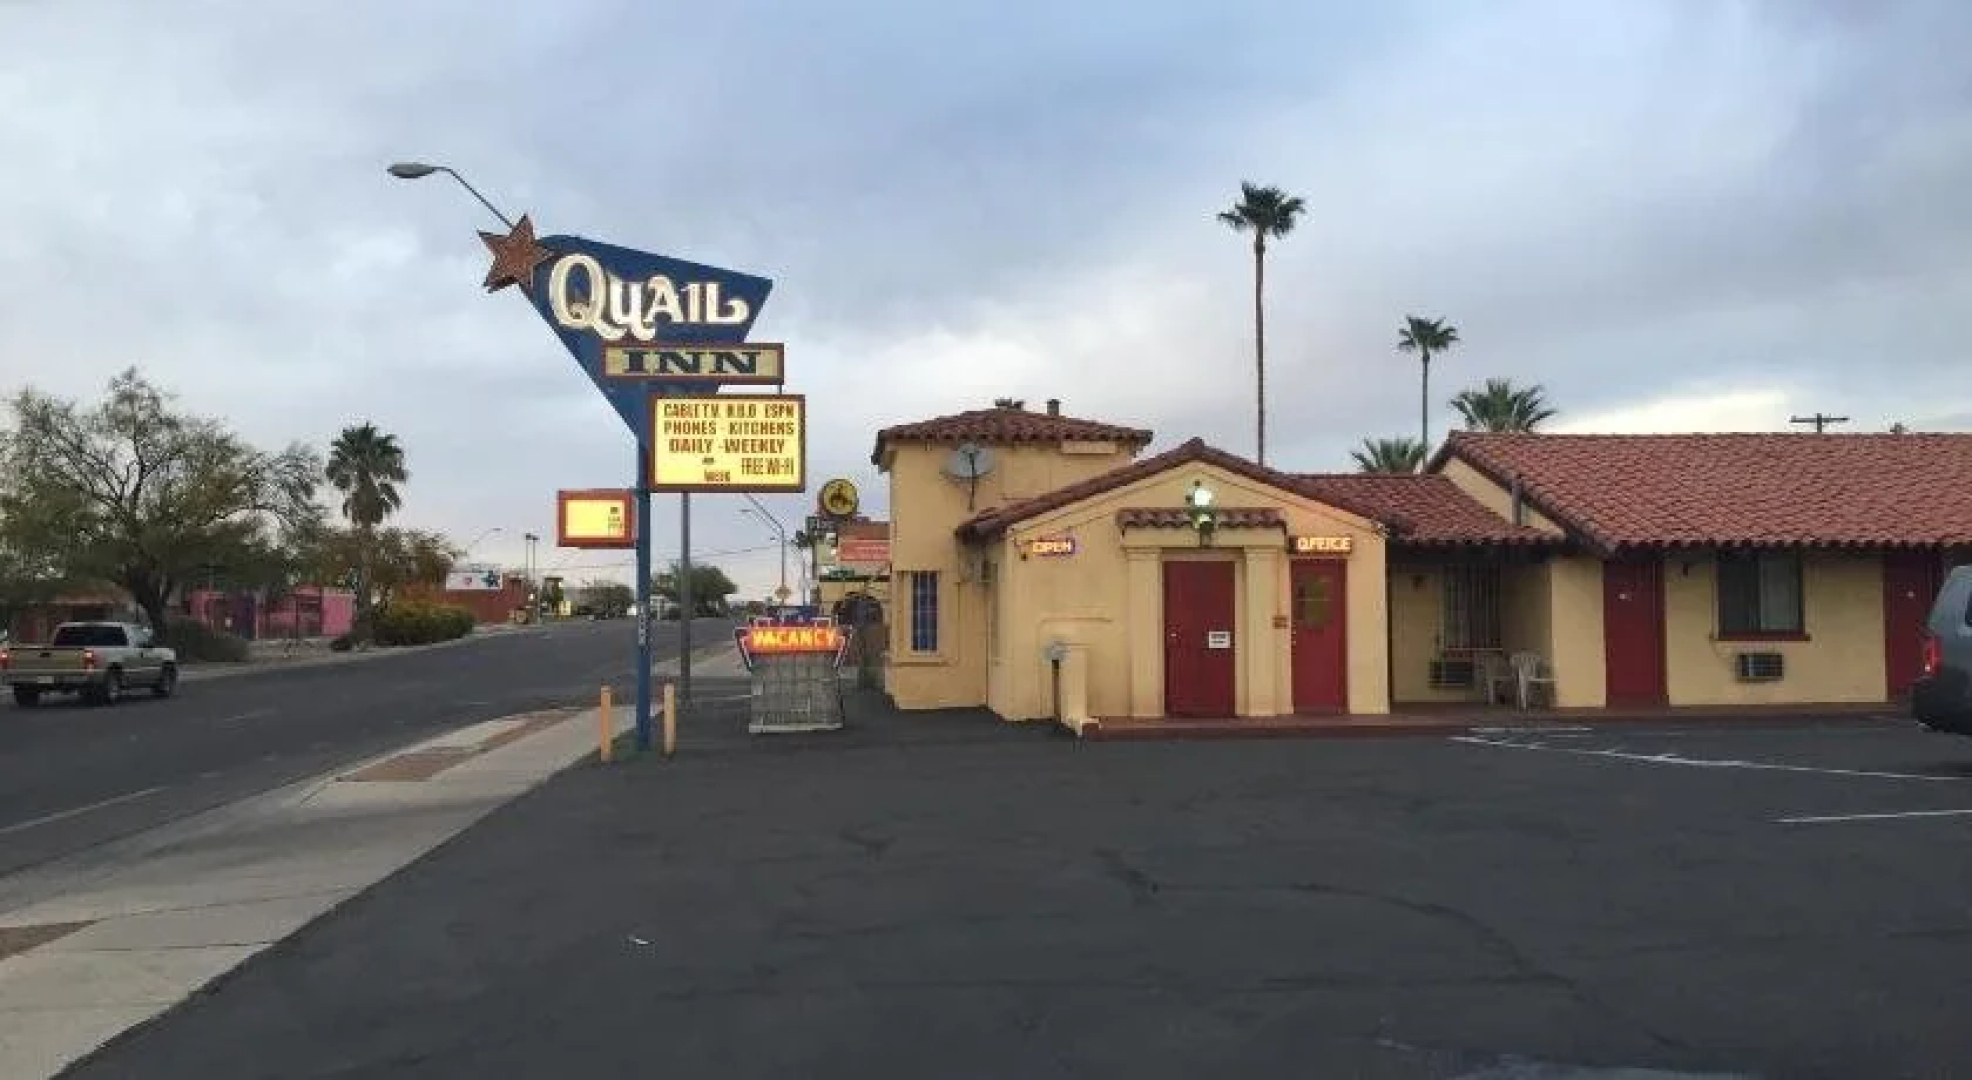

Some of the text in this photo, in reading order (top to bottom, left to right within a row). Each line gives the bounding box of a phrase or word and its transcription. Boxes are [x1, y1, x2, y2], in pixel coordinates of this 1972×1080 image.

[624, 351, 761, 374] INN
[663, 403, 700, 418] CABLE
[764, 403, 794, 418] ESPN
[663, 421, 717, 435] PHONES
[729, 421, 794, 435] KITCHENS
[668, 438, 714, 453] DAILY
[741, 457, 764, 475] FREE
[1032, 541, 1071, 553] OPEN
[1297, 536, 1352, 551] OFFICE
[750, 627, 838, 651] VACANCY
